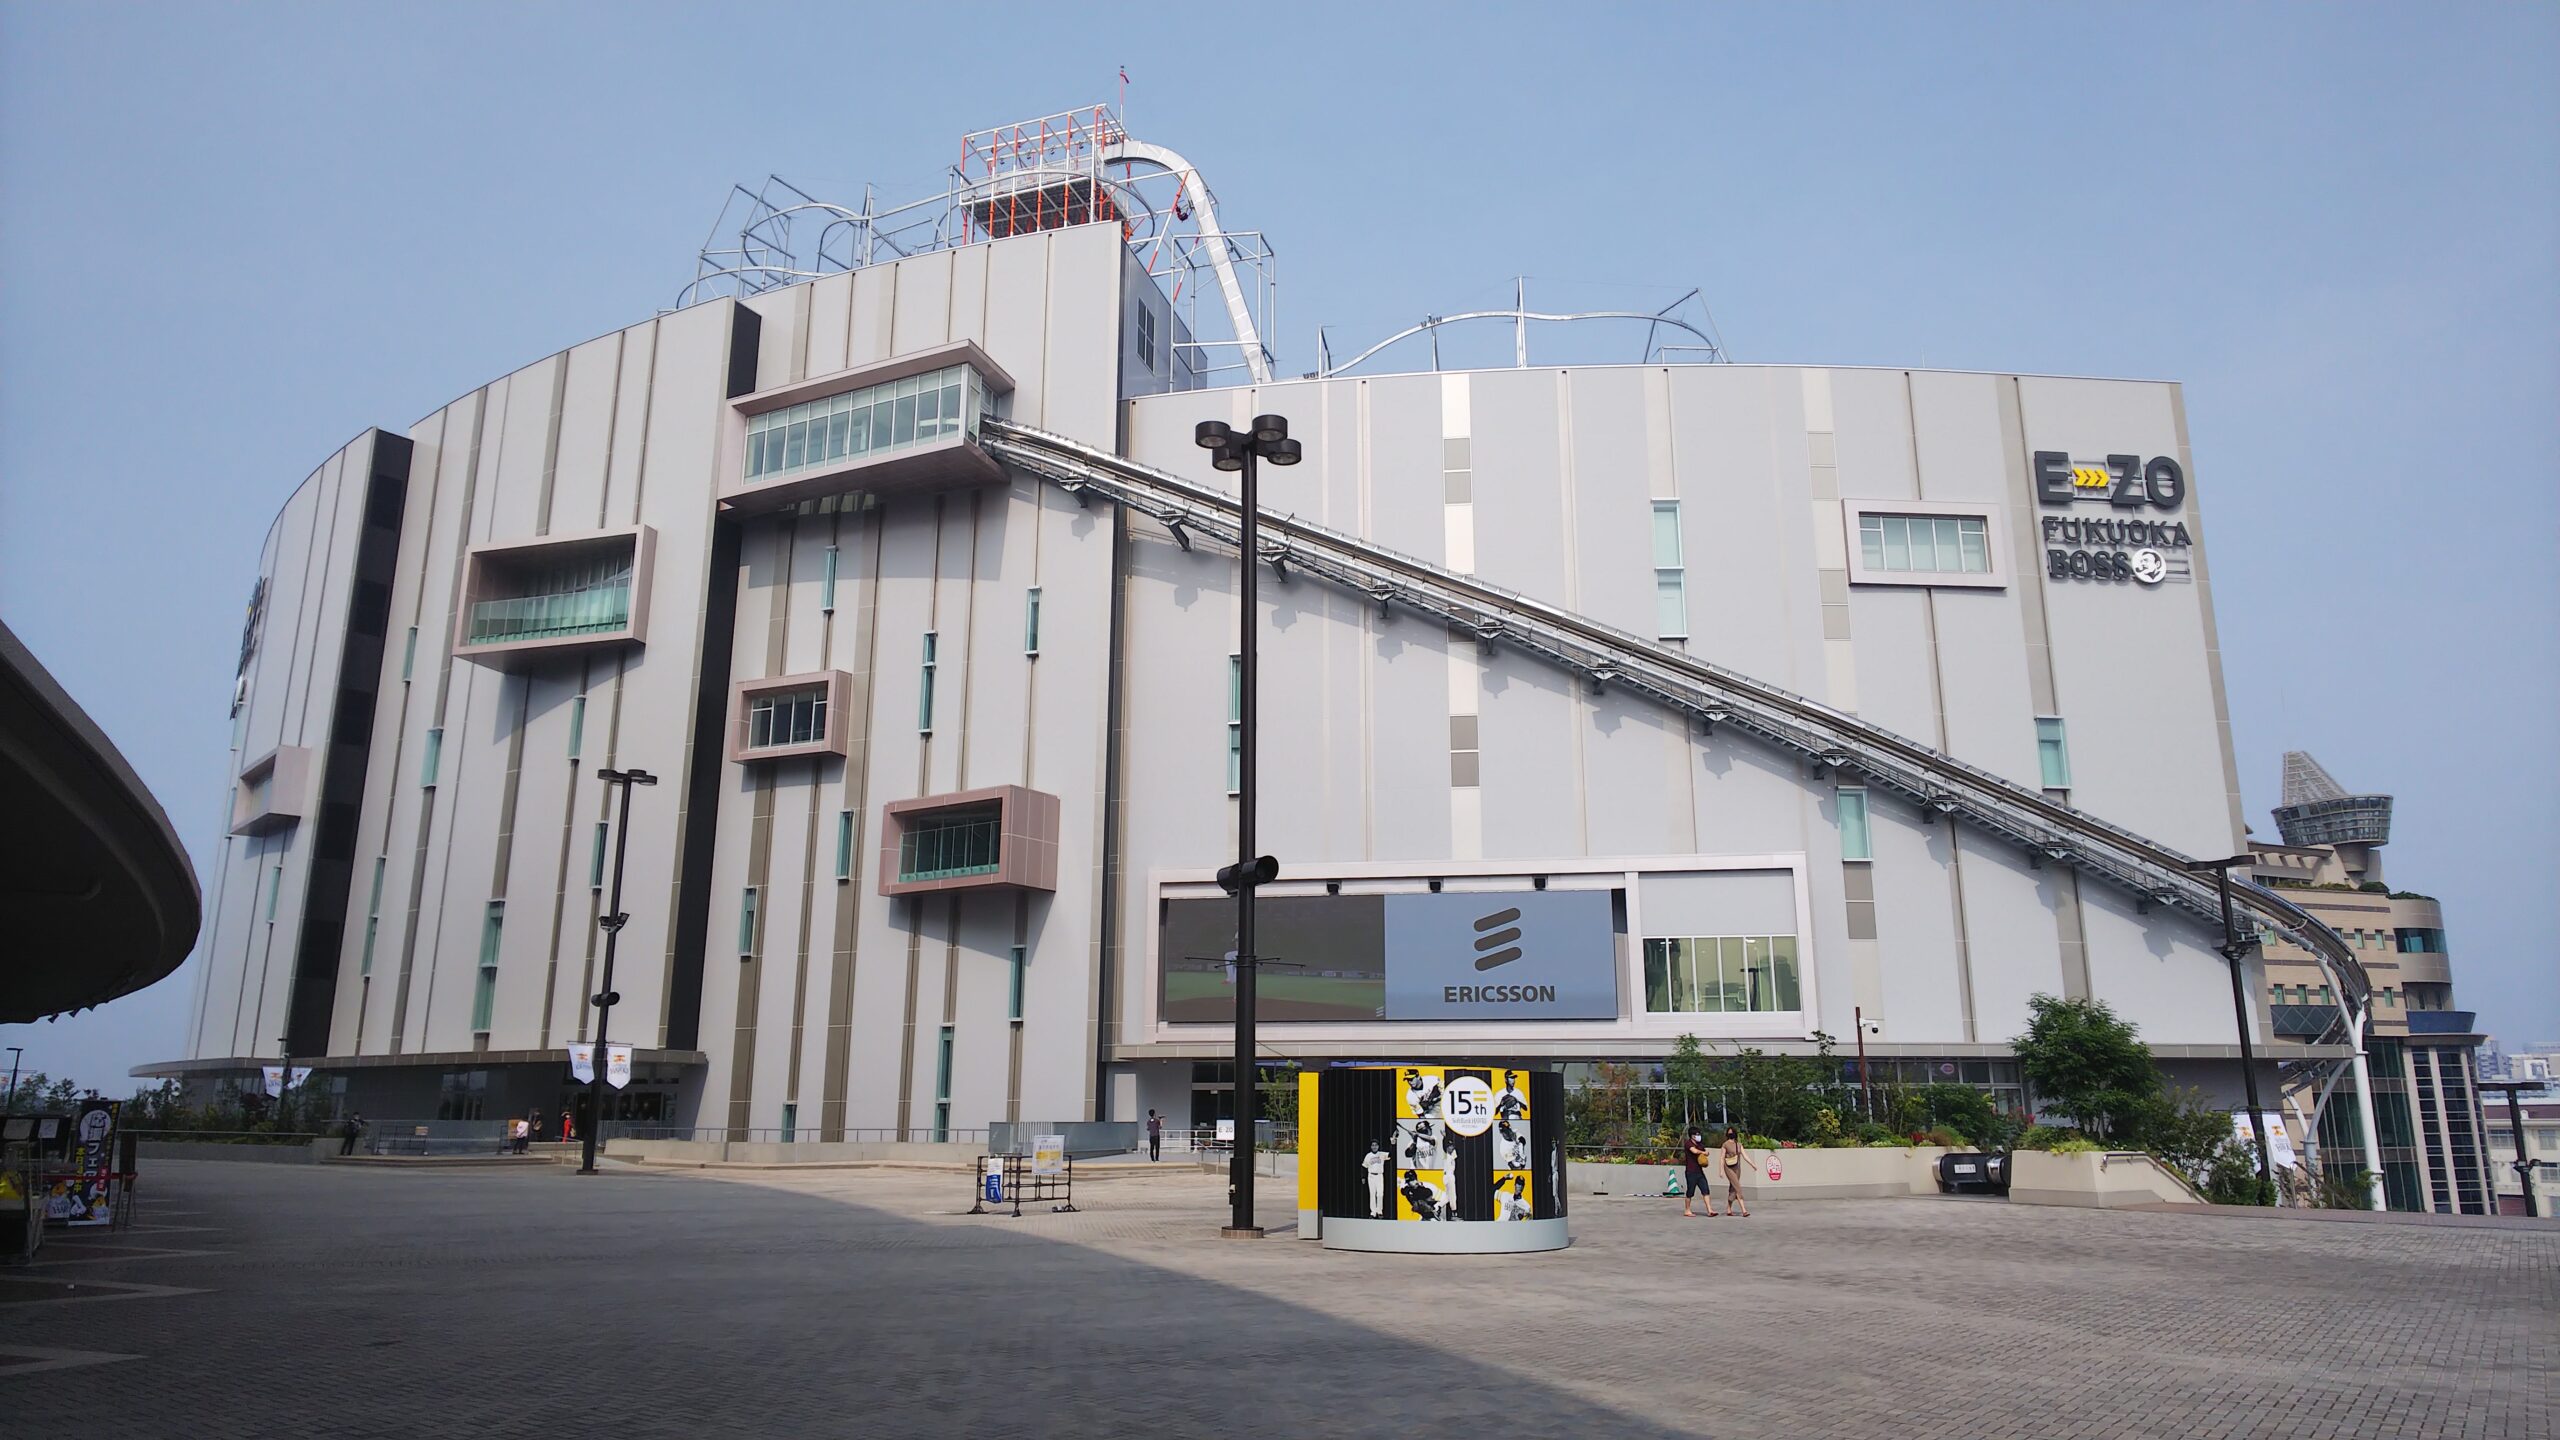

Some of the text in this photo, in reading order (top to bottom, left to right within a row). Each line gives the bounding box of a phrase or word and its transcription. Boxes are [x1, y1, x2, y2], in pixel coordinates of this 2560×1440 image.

[2042, 516, 2193, 546] FUKUOKA
[2048, 549, 2133, 581] BOSS
[1443, 985, 1556, 1003] ERICSSON
